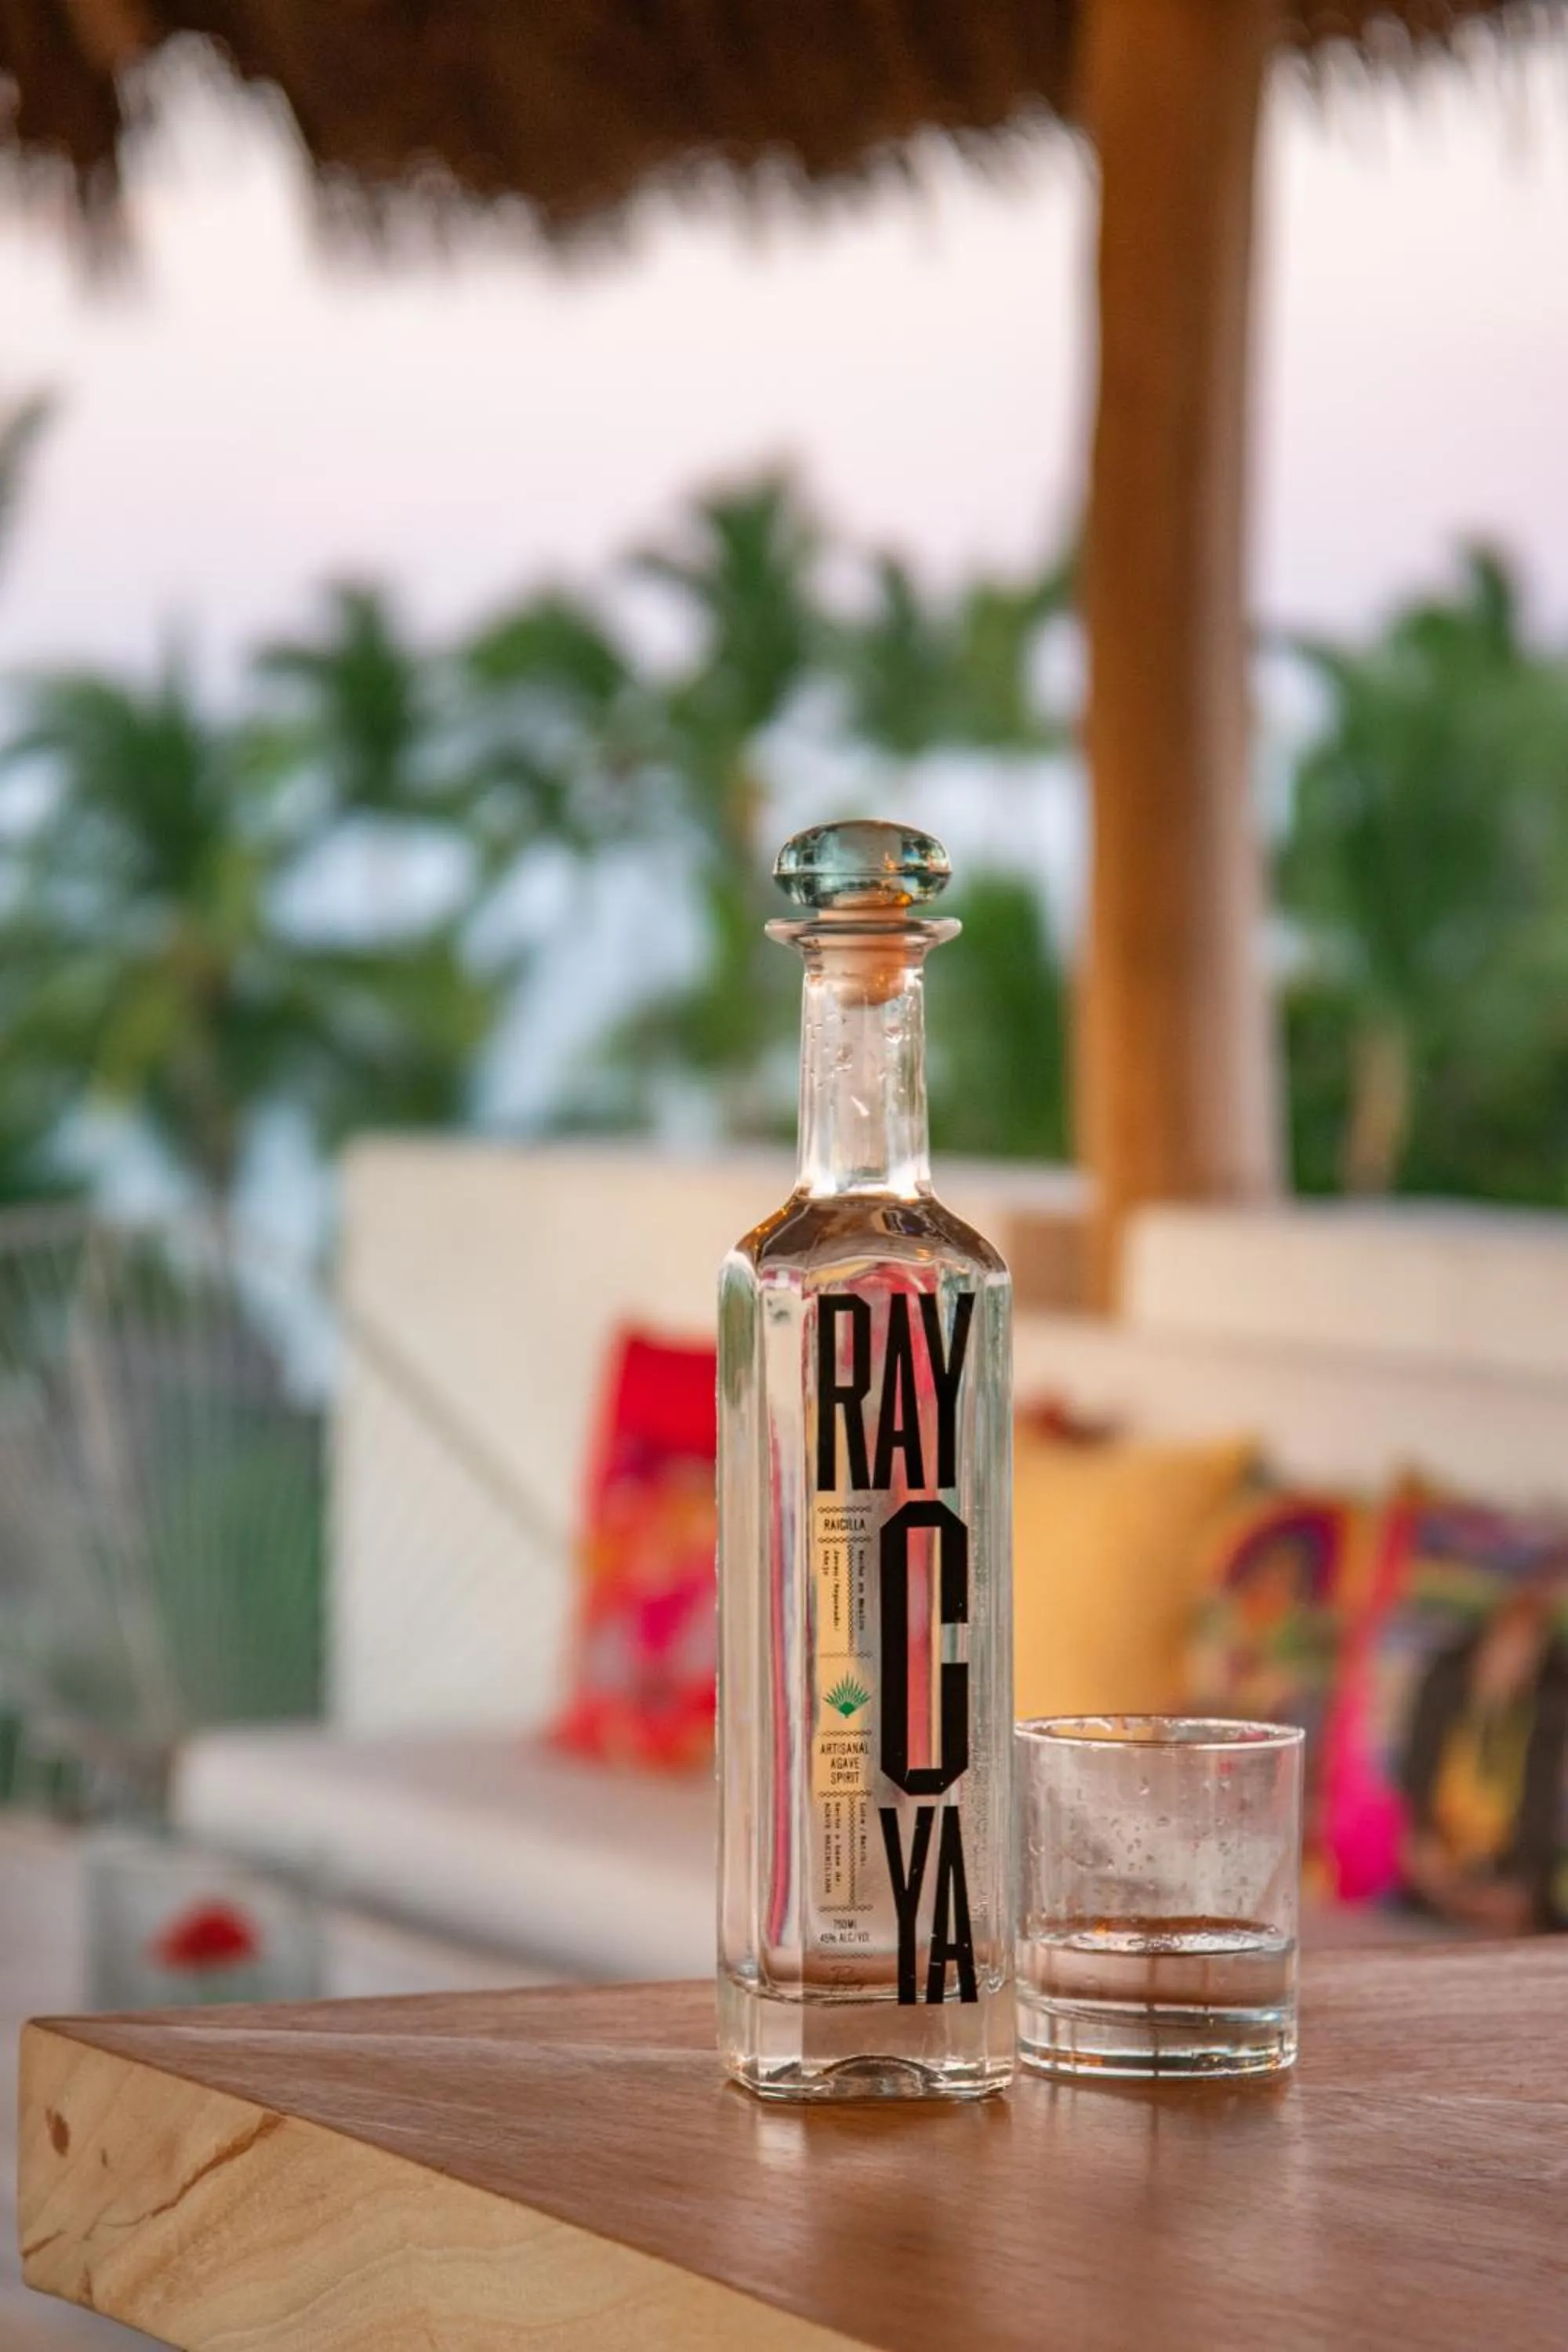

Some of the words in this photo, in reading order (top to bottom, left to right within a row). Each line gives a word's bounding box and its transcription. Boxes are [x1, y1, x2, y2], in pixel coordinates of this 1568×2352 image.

[817, 1292, 975, 1491] RAY
[824, 1518, 866, 1531] RAICILLA
[880, 1501, 968, 1795] C
[820, 1743, 869, 1755] ARTISANAL
[831, 1757, 860, 1769] AGAVE
[830, 1771, 859, 1784] SPIRIT
[879, 1806, 978, 2005] YA
